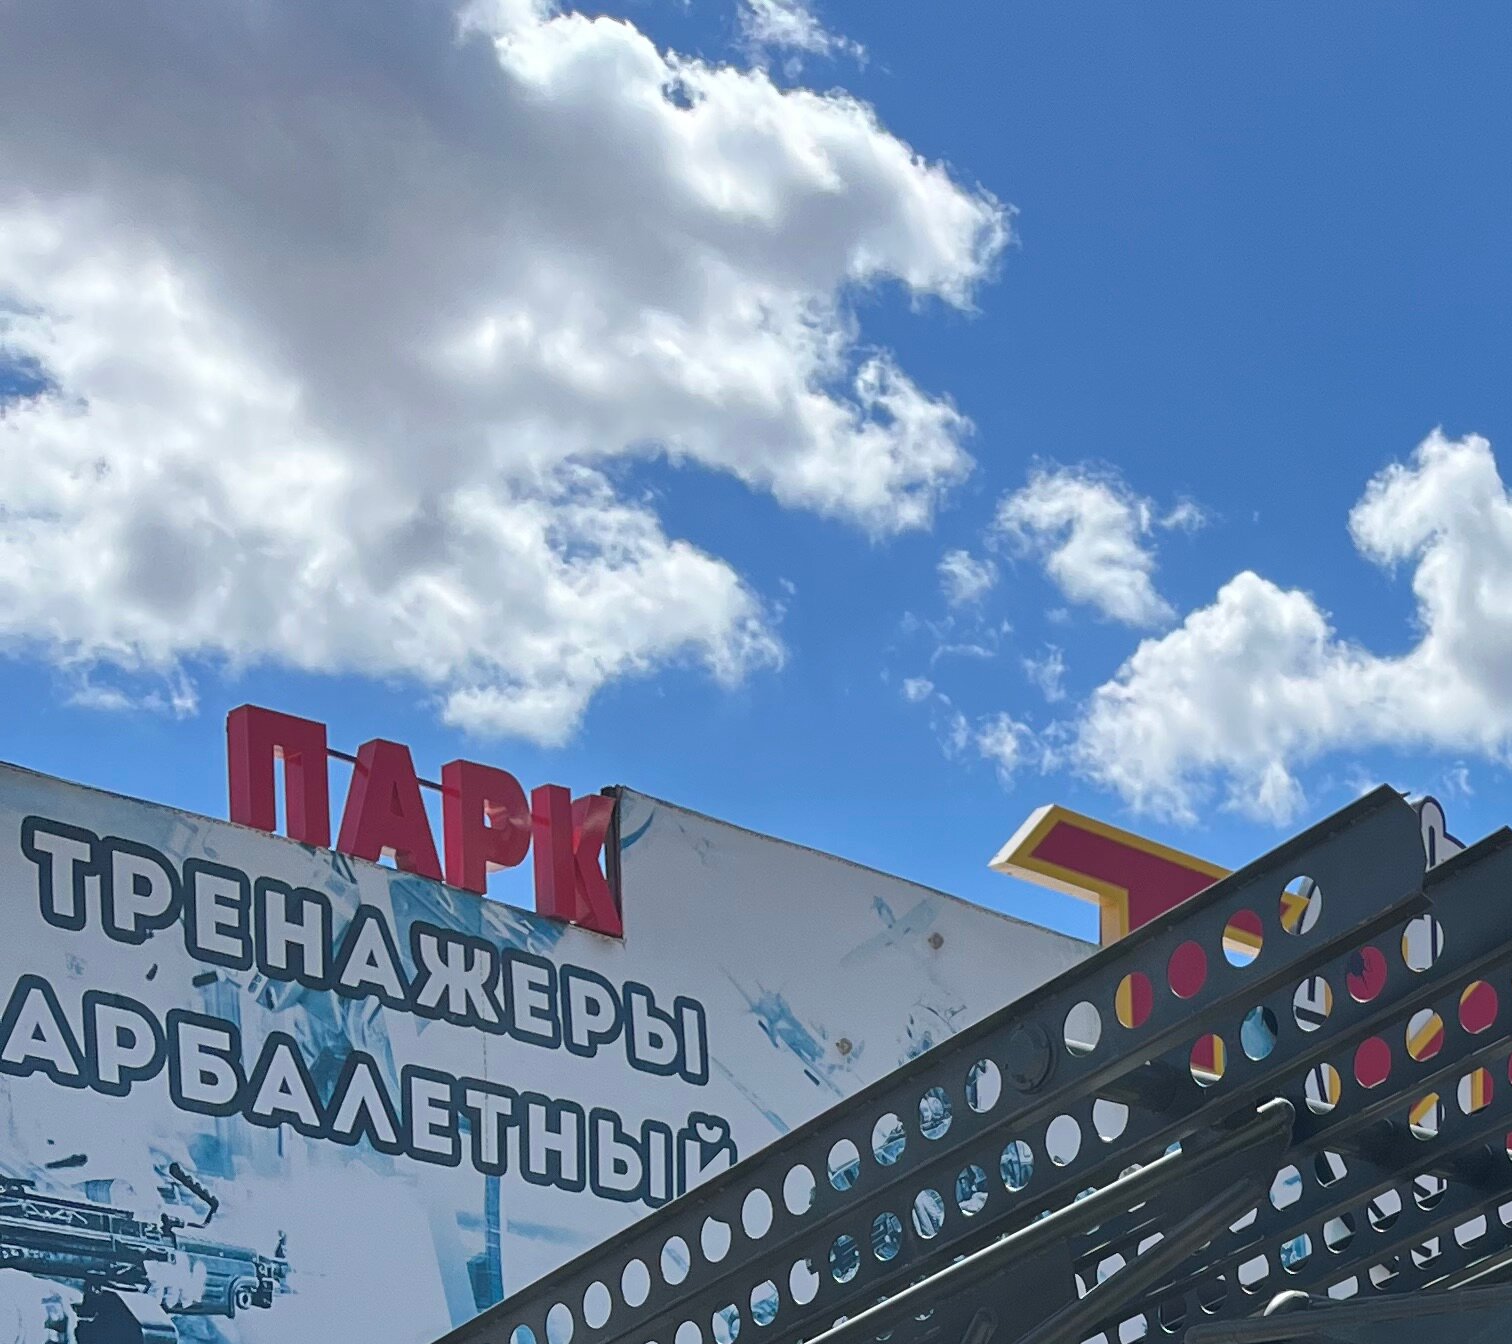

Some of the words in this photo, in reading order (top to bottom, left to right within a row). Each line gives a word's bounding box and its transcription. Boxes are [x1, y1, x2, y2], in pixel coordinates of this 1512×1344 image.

[227, 704, 624, 938] ПАРК
[22, 815, 708, 1085] ТРЕНАЖЕРЫ
[0, 974, 738, 1207] АРБАЛЕТНЫЙ
